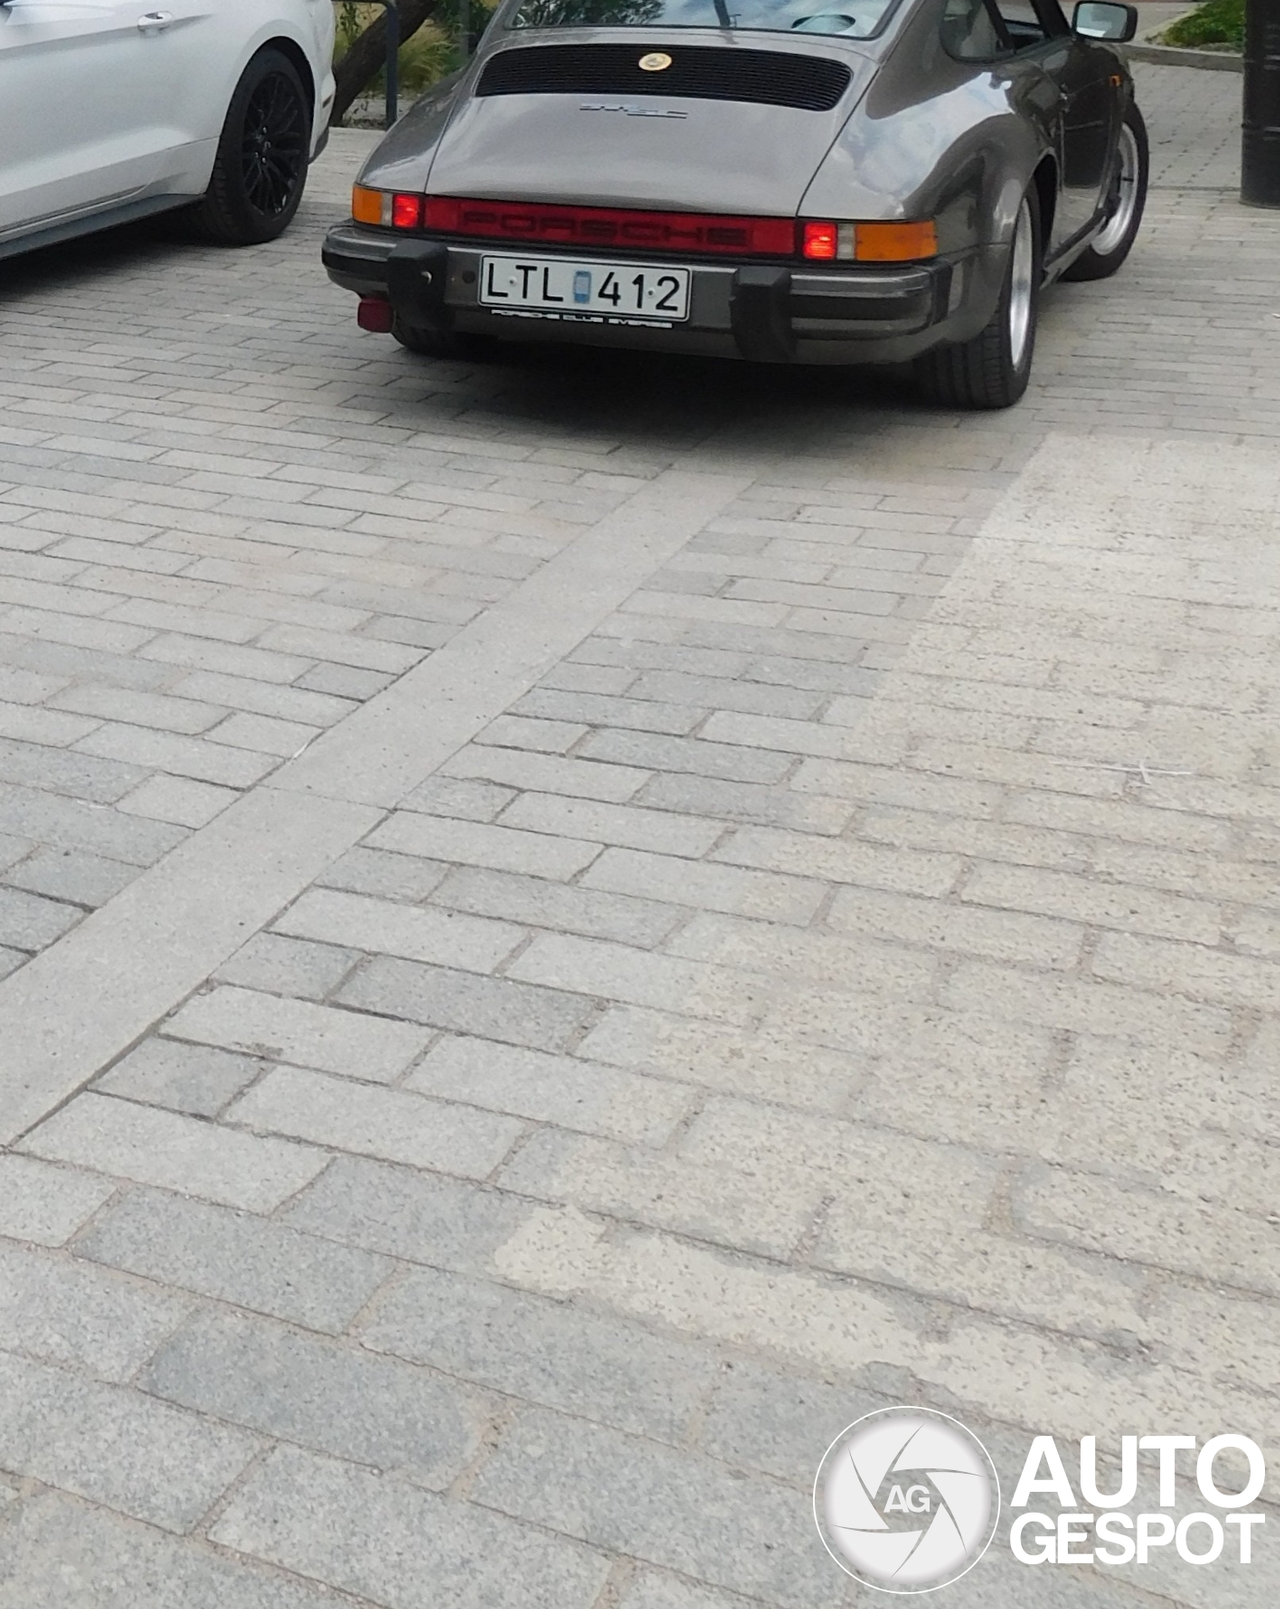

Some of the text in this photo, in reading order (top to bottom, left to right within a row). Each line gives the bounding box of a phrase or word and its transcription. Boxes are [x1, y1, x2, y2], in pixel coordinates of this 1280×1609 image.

[463, 211, 748, 245] PORSCHE
[488, 262, 680, 312] LTL 412
